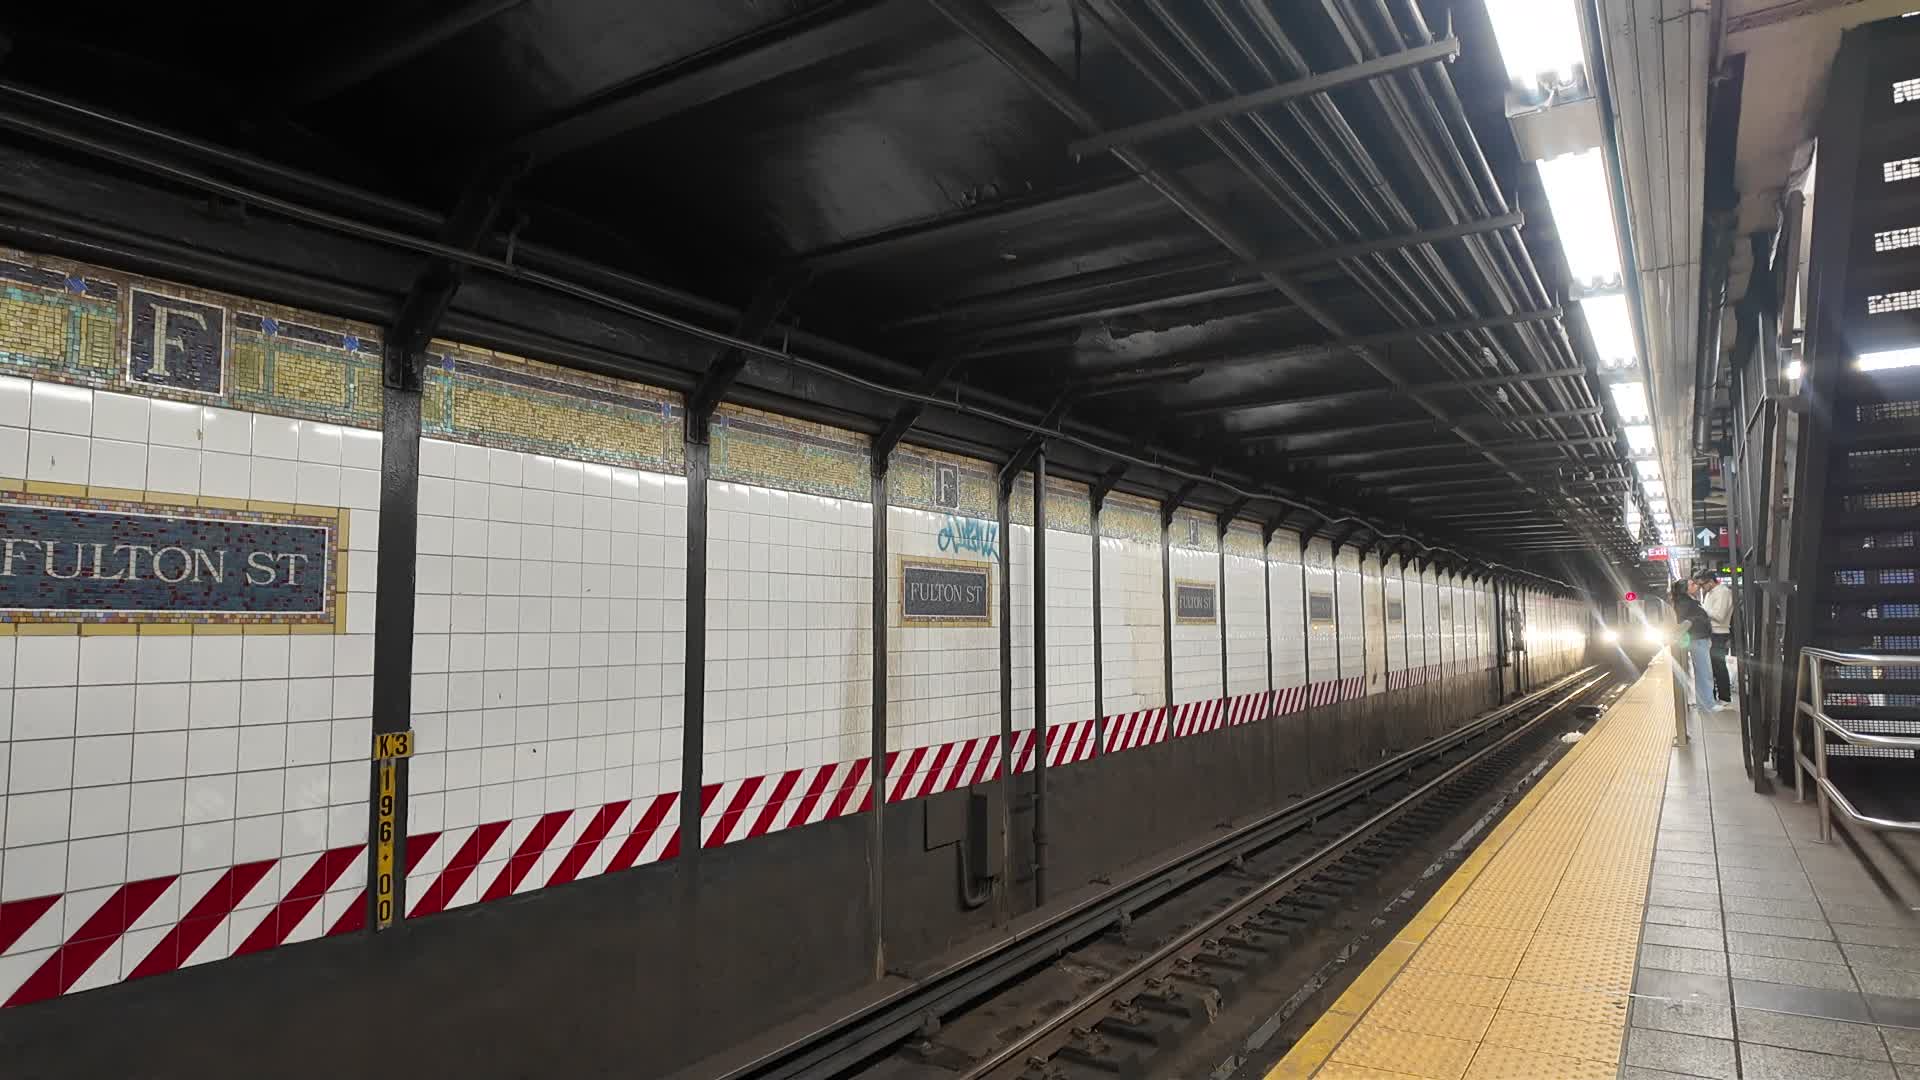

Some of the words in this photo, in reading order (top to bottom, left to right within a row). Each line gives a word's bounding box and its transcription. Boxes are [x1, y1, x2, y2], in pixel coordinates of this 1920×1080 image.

[147, 302, 208, 377] F
[940, 467, 955, 503] F
[0, 537, 226, 584] FULTON
[245, 550, 309, 586] ST
[1648, 547, 1667, 556] Exit
[910, 582, 962, 601] FULTON
[966, 585, 982, 602] ST
